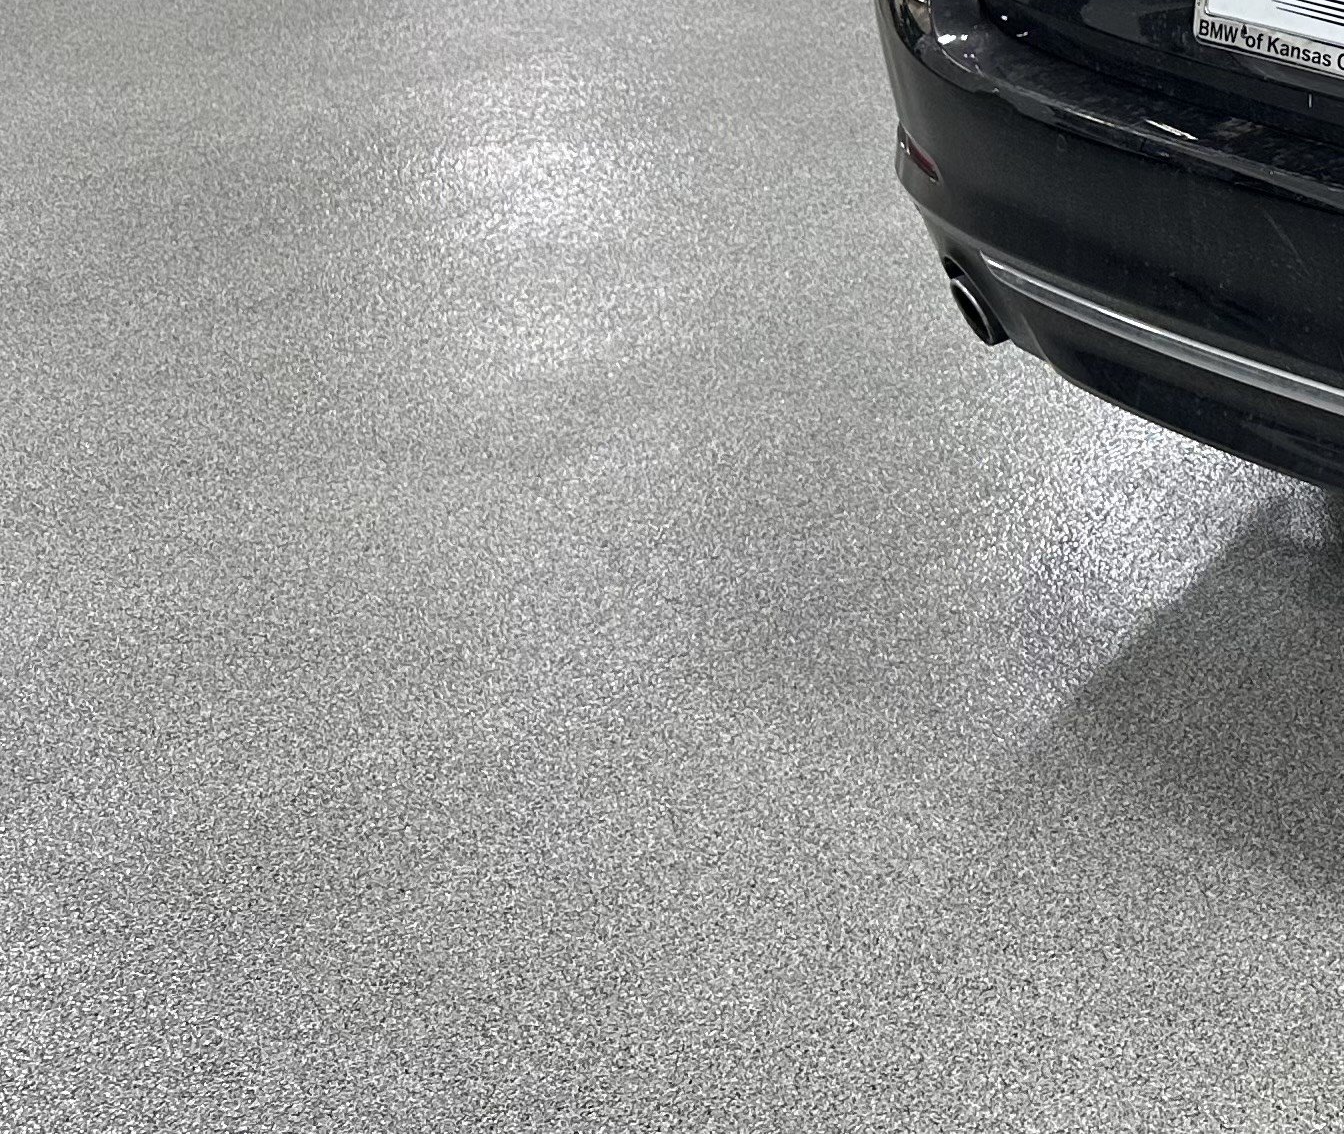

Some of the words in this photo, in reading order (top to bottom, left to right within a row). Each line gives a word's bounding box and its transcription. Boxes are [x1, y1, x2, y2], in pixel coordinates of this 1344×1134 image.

[1199, 19, 1239, 44] BMW
[1245, 32, 1264, 49] of
[1267, 37, 1332, 67] Kansas
